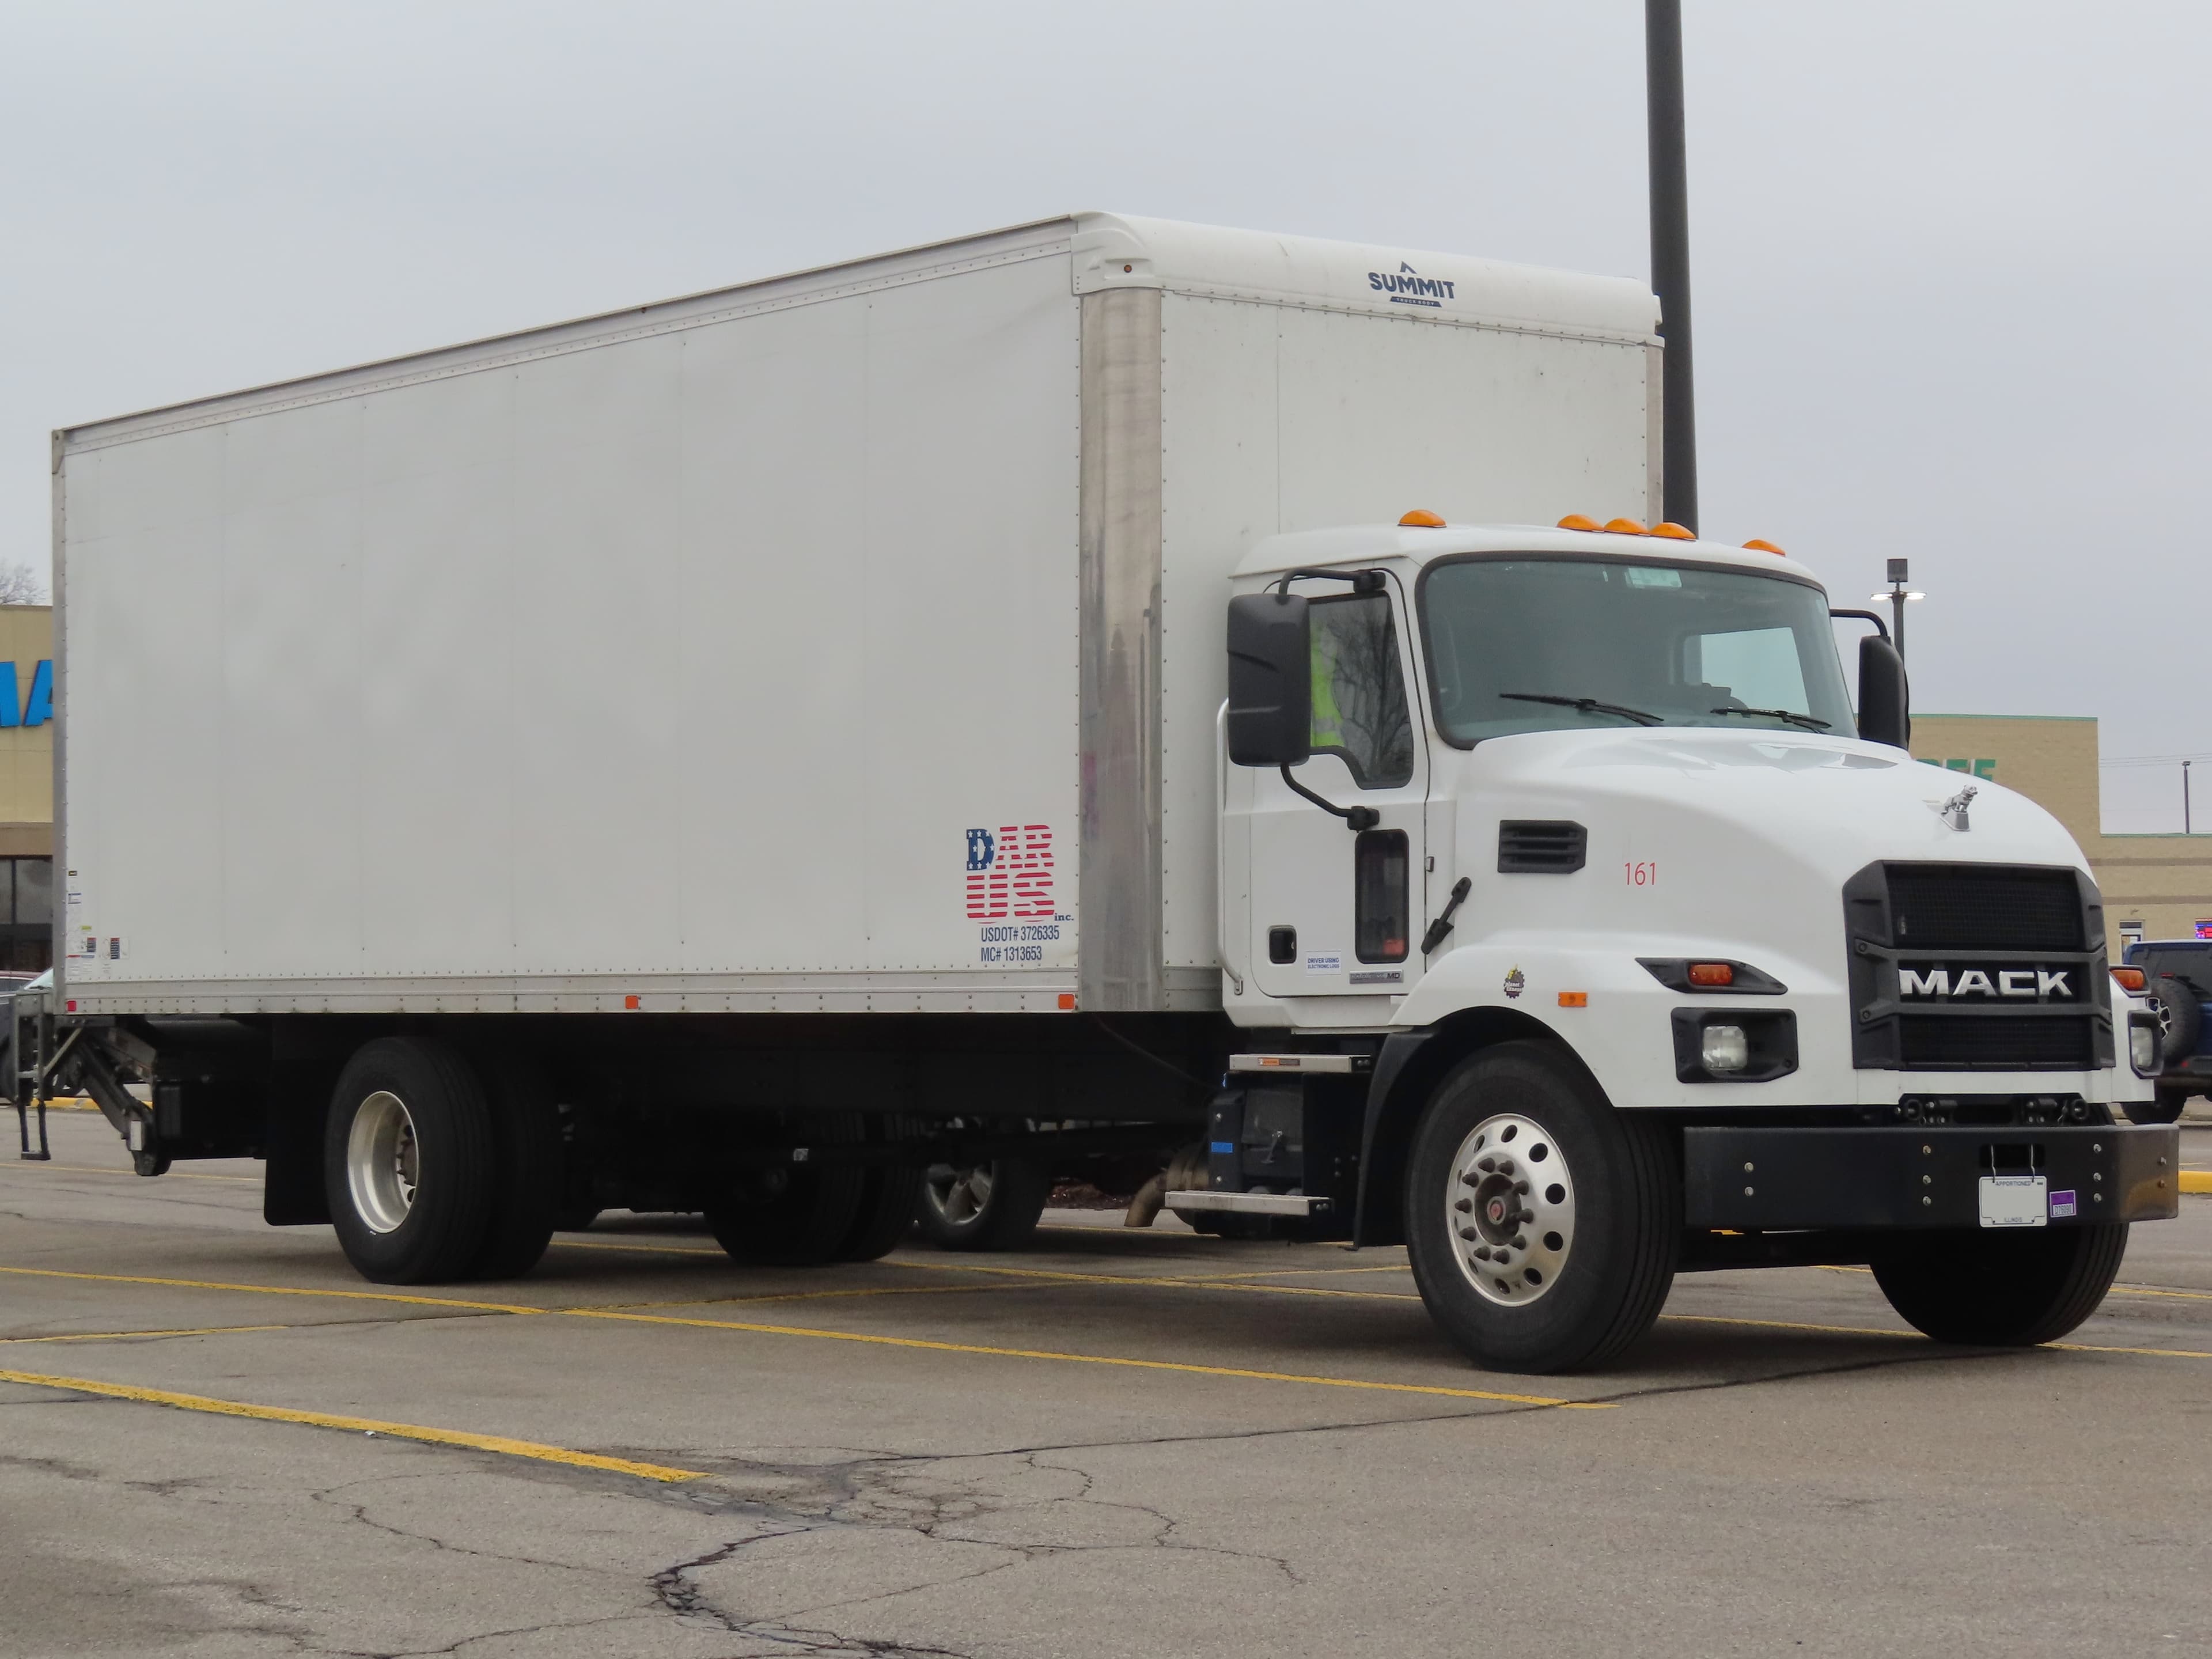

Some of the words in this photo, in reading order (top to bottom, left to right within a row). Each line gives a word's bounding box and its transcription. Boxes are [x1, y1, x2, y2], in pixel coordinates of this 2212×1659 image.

[1368, 272, 1455, 299] SUMMIT
[1624, 862, 1657, 885] 161
[1054, 913, 1074, 921] inc.
[981, 926, 1018, 942] USDOT#
[1020, 925, 1059, 941] 3726335
[980, 947, 1001, 961] MC#
[1003, 946, 1042, 961] 1313653
[1898, 969, 2073, 996] MACK
